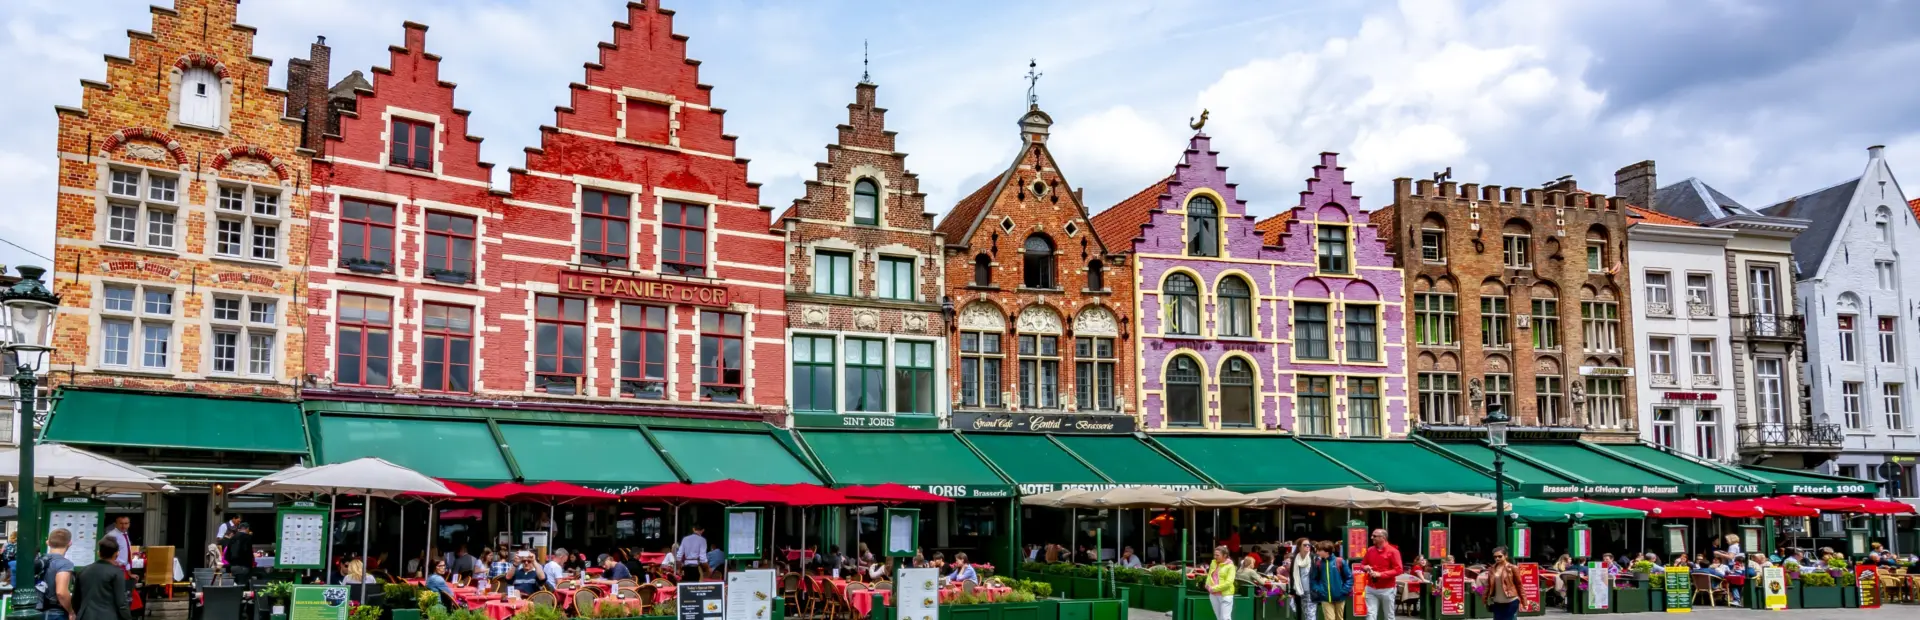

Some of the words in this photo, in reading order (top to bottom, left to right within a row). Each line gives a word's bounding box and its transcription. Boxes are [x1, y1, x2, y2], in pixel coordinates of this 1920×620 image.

[568, 277, 595, 292] LE
[600, 277, 675, 299] PANIER
[681, 286, 725, 304] D'OR
[843, 417, 865, 426] SINT
[868, 417, 895, 427] JORIS
[973, 418, 997, 430] Grand
[1029, 415, 1062, 431] Central
[1075, 420, 1114, 430] Brasserie
[928, 485, 967, 497] JORIS
[973, 489, 1007, 497] Brasserie
[1020, 484, 1055, 495] HOTEL
[1543, 484, 1579, 493] Brasserie
[1584, 485, 1595, 494] La
[1620, 486, 1636, 494] d'Or
[1642, 485, 1679, 494] Restaurant
[1714, 484, 1736, 494] PETIT
[1738, 485, 1758, 494] CAFE
[1792, 484, 1833, 494] Friterie
[1836, 484, 1865, 494] 1900
